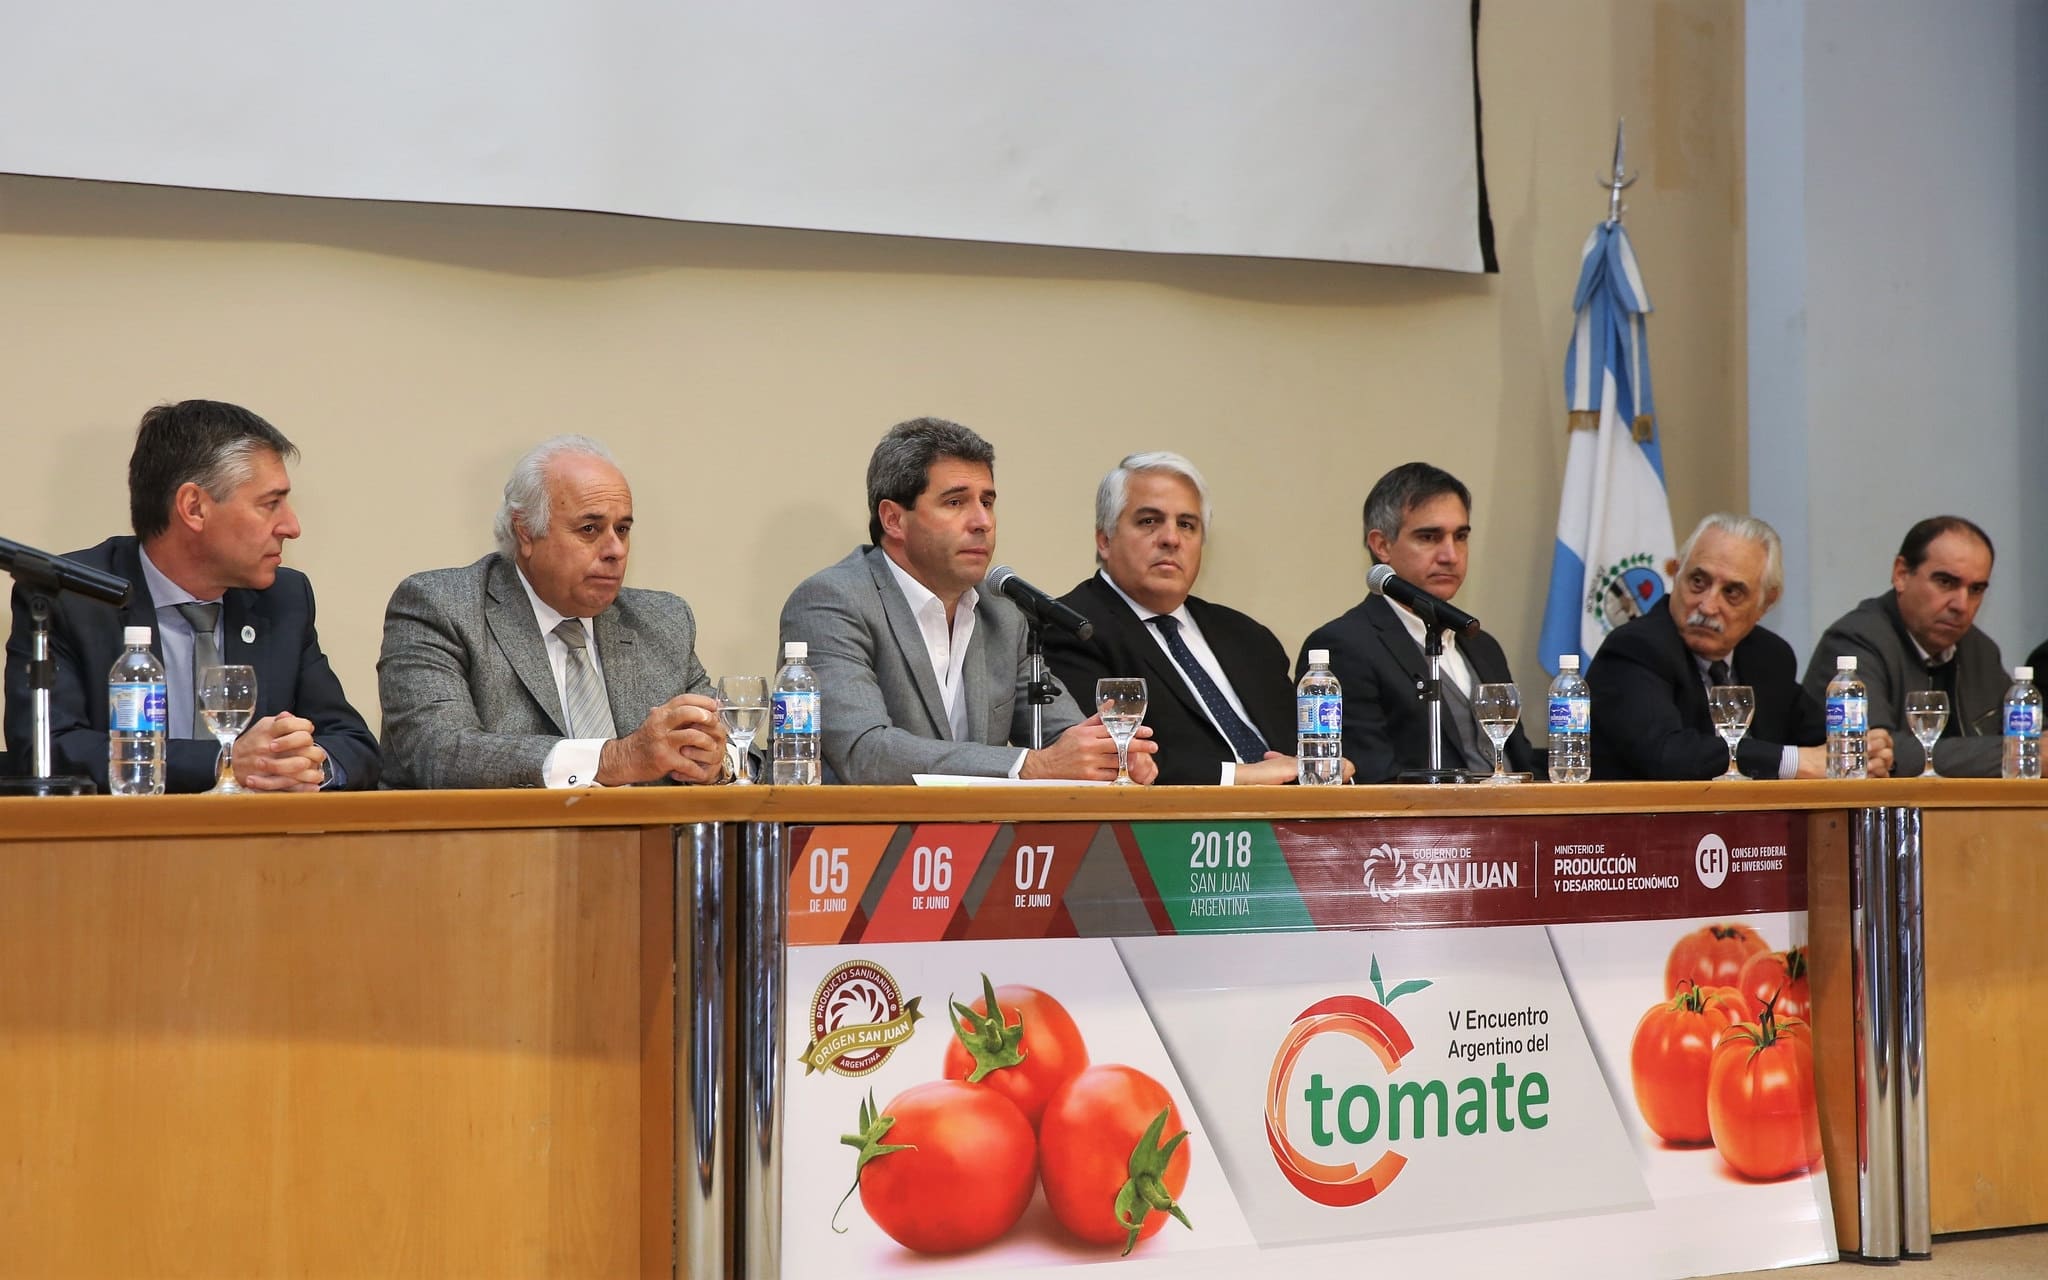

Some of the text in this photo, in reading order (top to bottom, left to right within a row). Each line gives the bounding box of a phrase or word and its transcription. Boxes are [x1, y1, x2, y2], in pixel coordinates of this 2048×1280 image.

[1190, 831, 1252, 868] 2018
[1412, 847, 1472, 860] GOBIERNO DE
[1554, 844, 1605, 855] MINISTERIO DE
[1700, 848, 1723, 874] CFI
[1731, 845, 1787, 859] CONSEJO FEDERAL
[809, 847, 849, 894] 05
[912, 846, 953, 892] 06
[1015, 845, 1055, 890] 07
[1412, 861, 1518, 889] SAN JUAN
[1554, 853, 1637, 876] PRODUCCIÓN
[1732, 860, 1783, 873] DE INVERSIONES
[1190, 872, 1250, 893] SAN JUAN
[1554, 873, 1680, 892] Y DESARROLLO ECONÓMICO
[809, 898, 847, 913] DE JUNIO
[912, 896, 950, 910] DE JUNIO
[1015, 894, 1051, 908] DE JUNIO
[1190, 897, 1250, 917] ARGENTINA
[816, 968, 895, 1019] PRODUCTO SANJUANINO
[1448, 1006, 1549, 1031] V Encuentro
[815, 1021, 910, 1065] ORIGEN SAN JUAN
[1448, 1033, 1549, 1062] Argentino del
[839, 1052, 881, 1069] ARGENTINA
[1304, 1062, 1550, 1147] tomate
